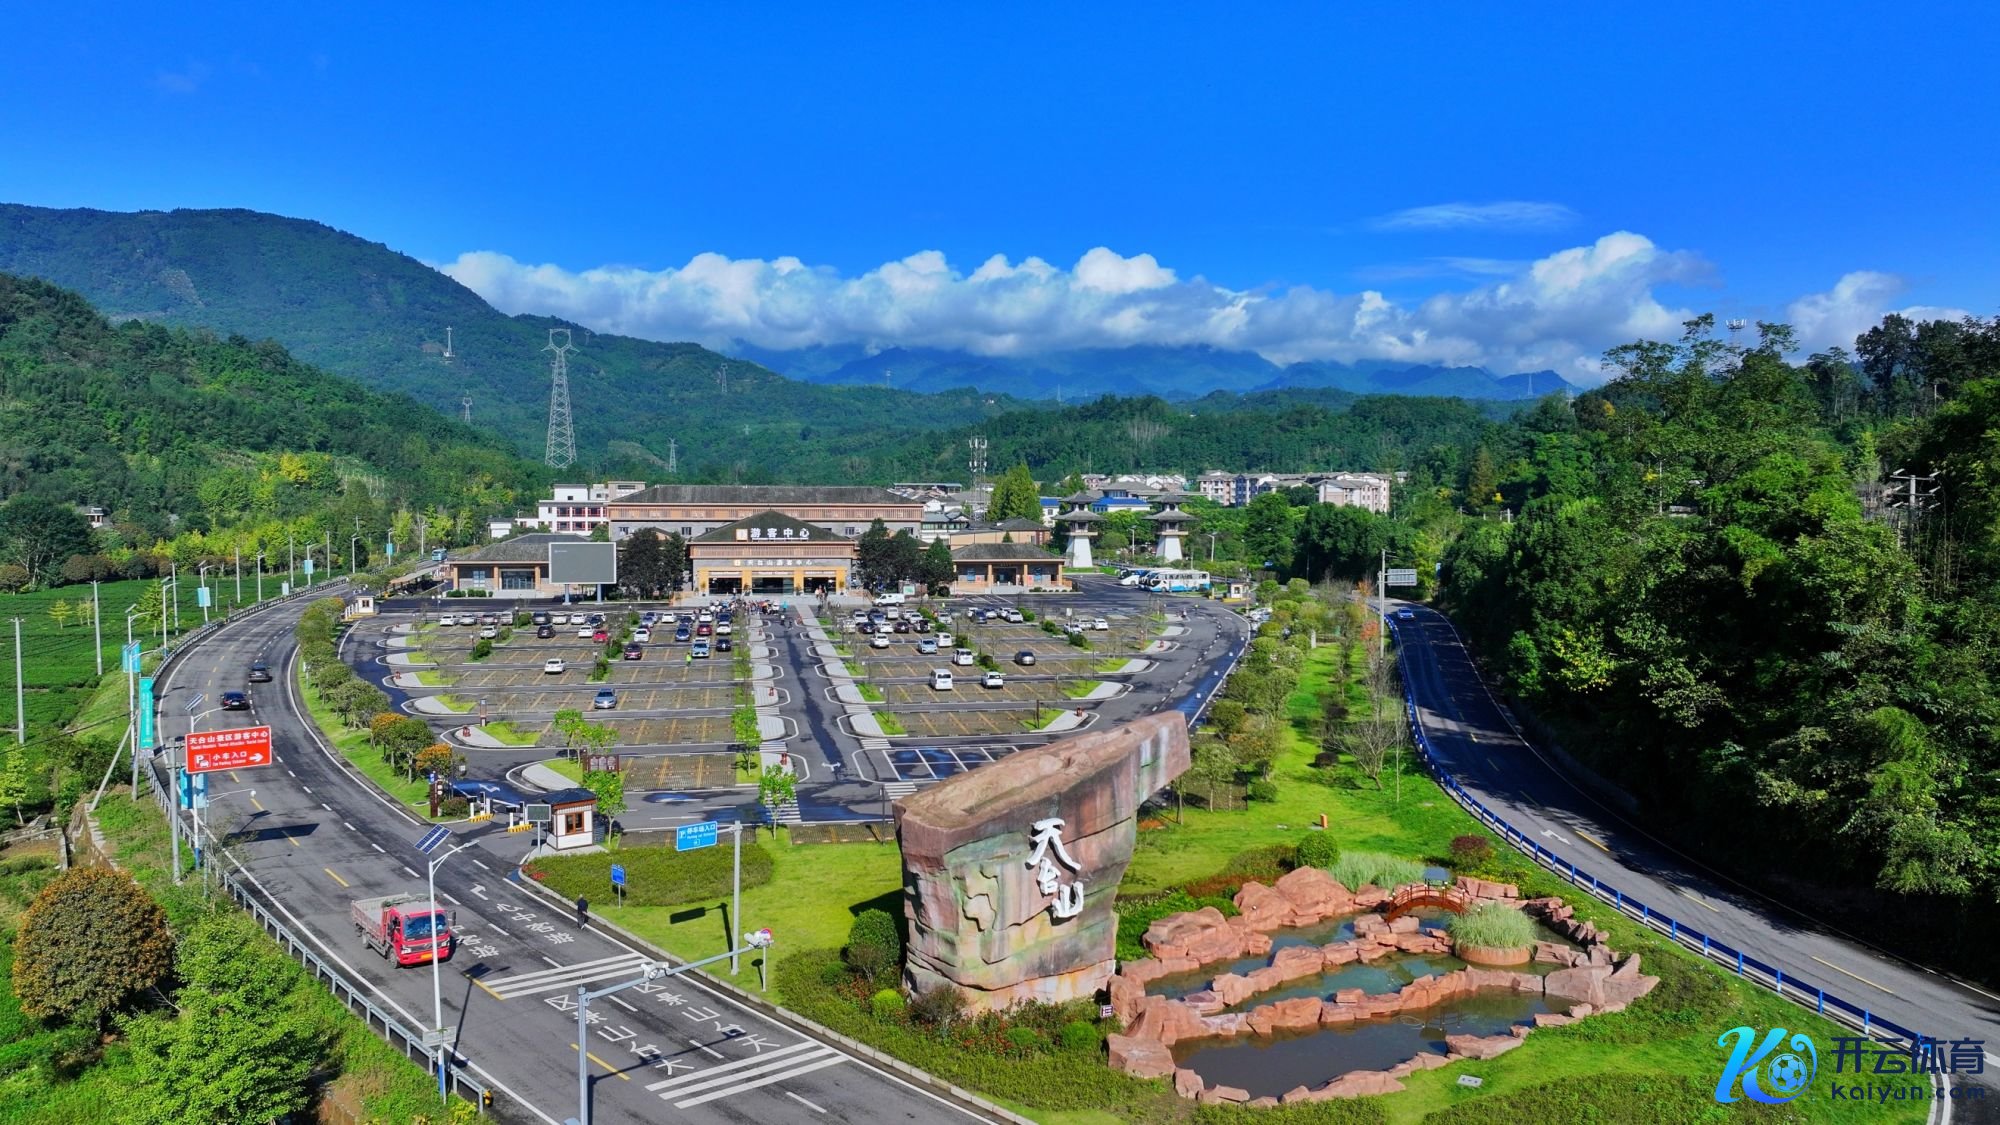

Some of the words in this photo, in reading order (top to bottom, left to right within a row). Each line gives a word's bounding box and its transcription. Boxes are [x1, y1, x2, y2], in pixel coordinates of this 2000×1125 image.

[751, 528, 810, 538] 游客中心
[213, 751, 247, 761] 小车入口
[1024, 817, 1084, 918] 天台山
